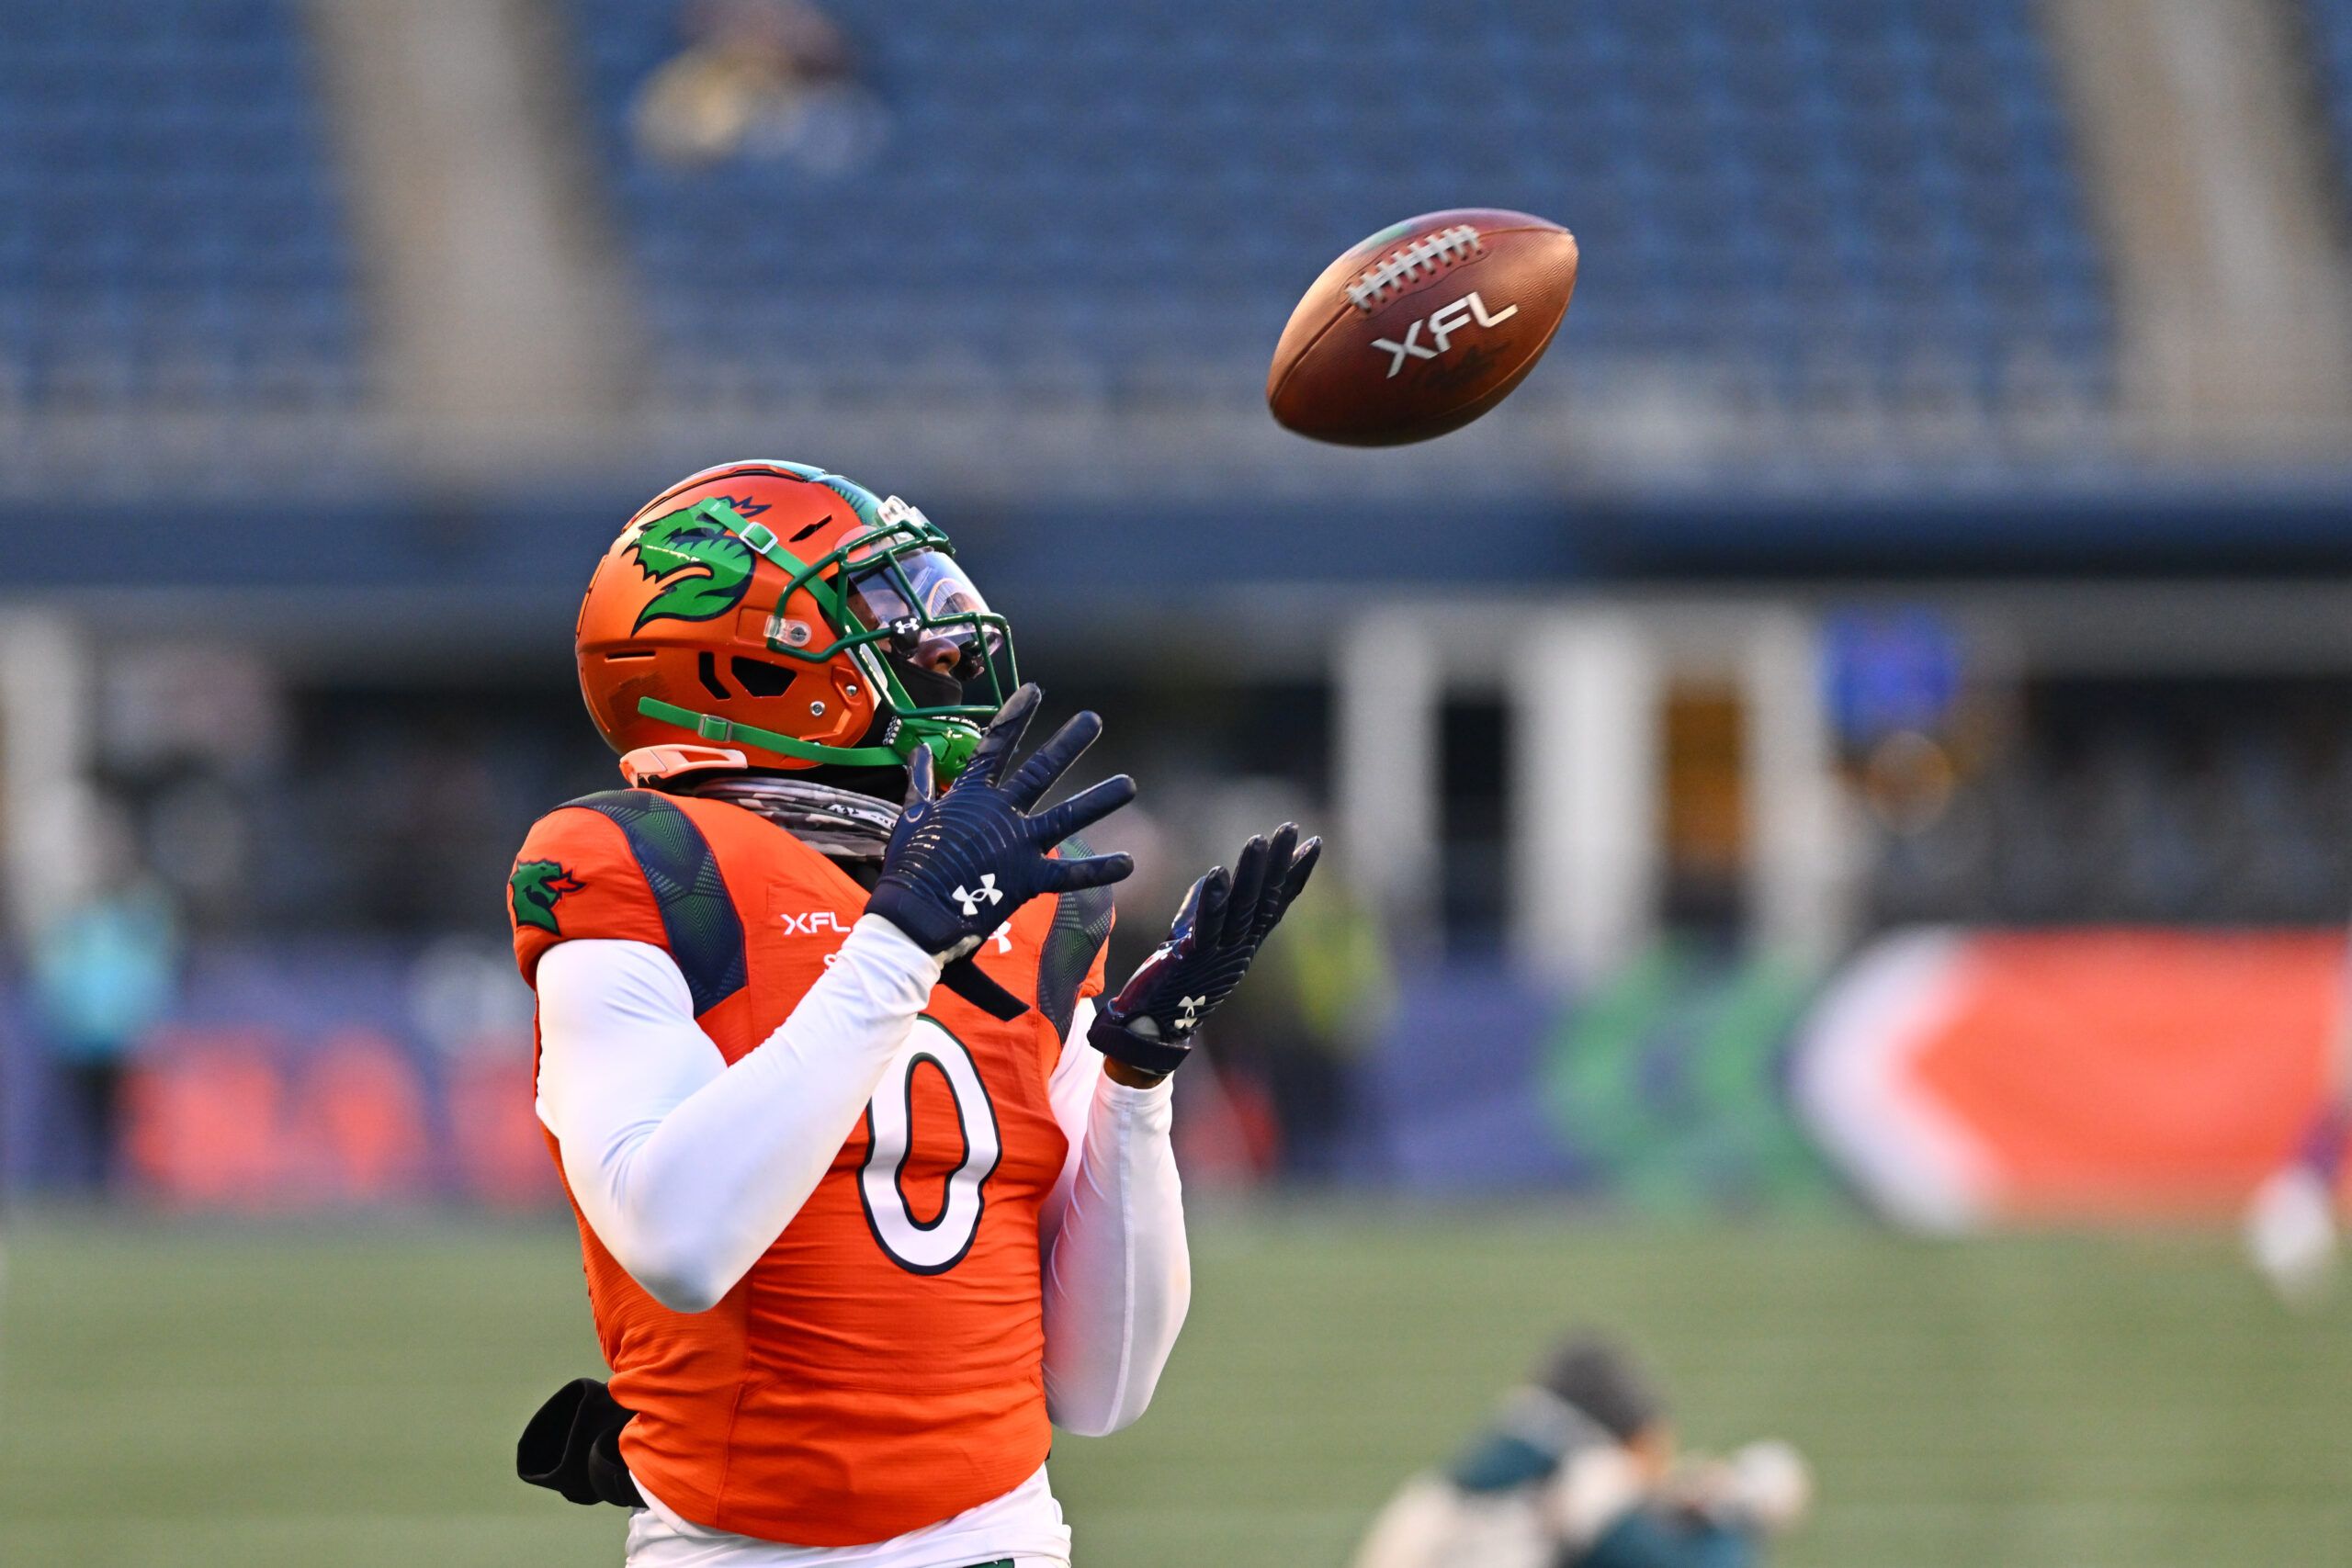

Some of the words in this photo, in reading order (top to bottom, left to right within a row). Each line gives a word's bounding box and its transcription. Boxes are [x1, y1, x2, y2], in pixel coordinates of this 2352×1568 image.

[1371, 291, 1519, 378] XFL
[780, 911, 852, 935] XFL
[857, 1012, 1002, 1276] 0
